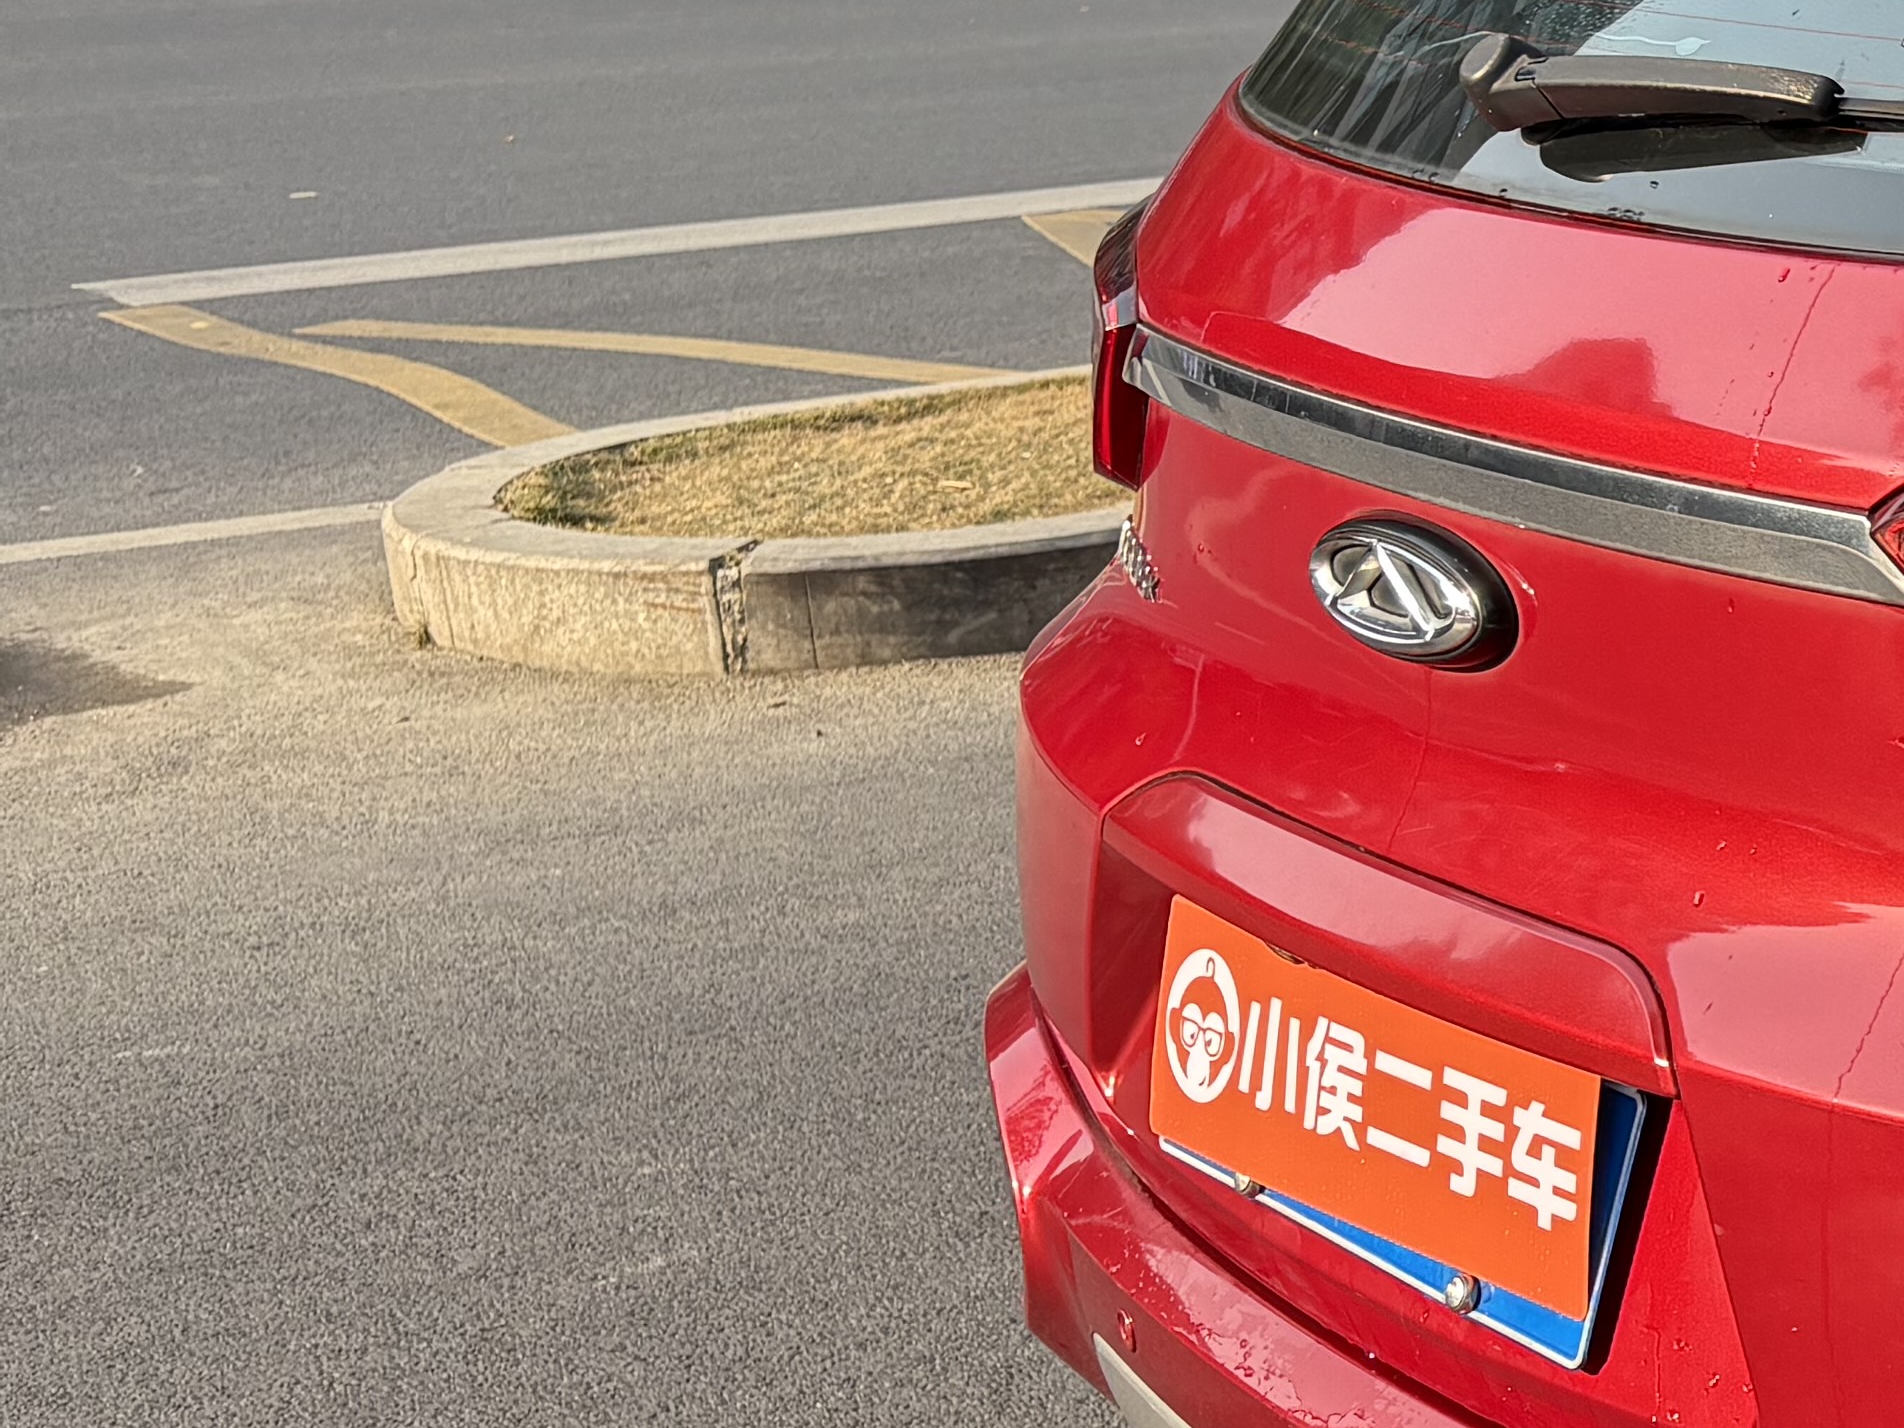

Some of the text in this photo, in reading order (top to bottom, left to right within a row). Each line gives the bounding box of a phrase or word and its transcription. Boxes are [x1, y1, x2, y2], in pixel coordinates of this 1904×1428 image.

[1238, 996, 1582, 1232] 小侯二手车
